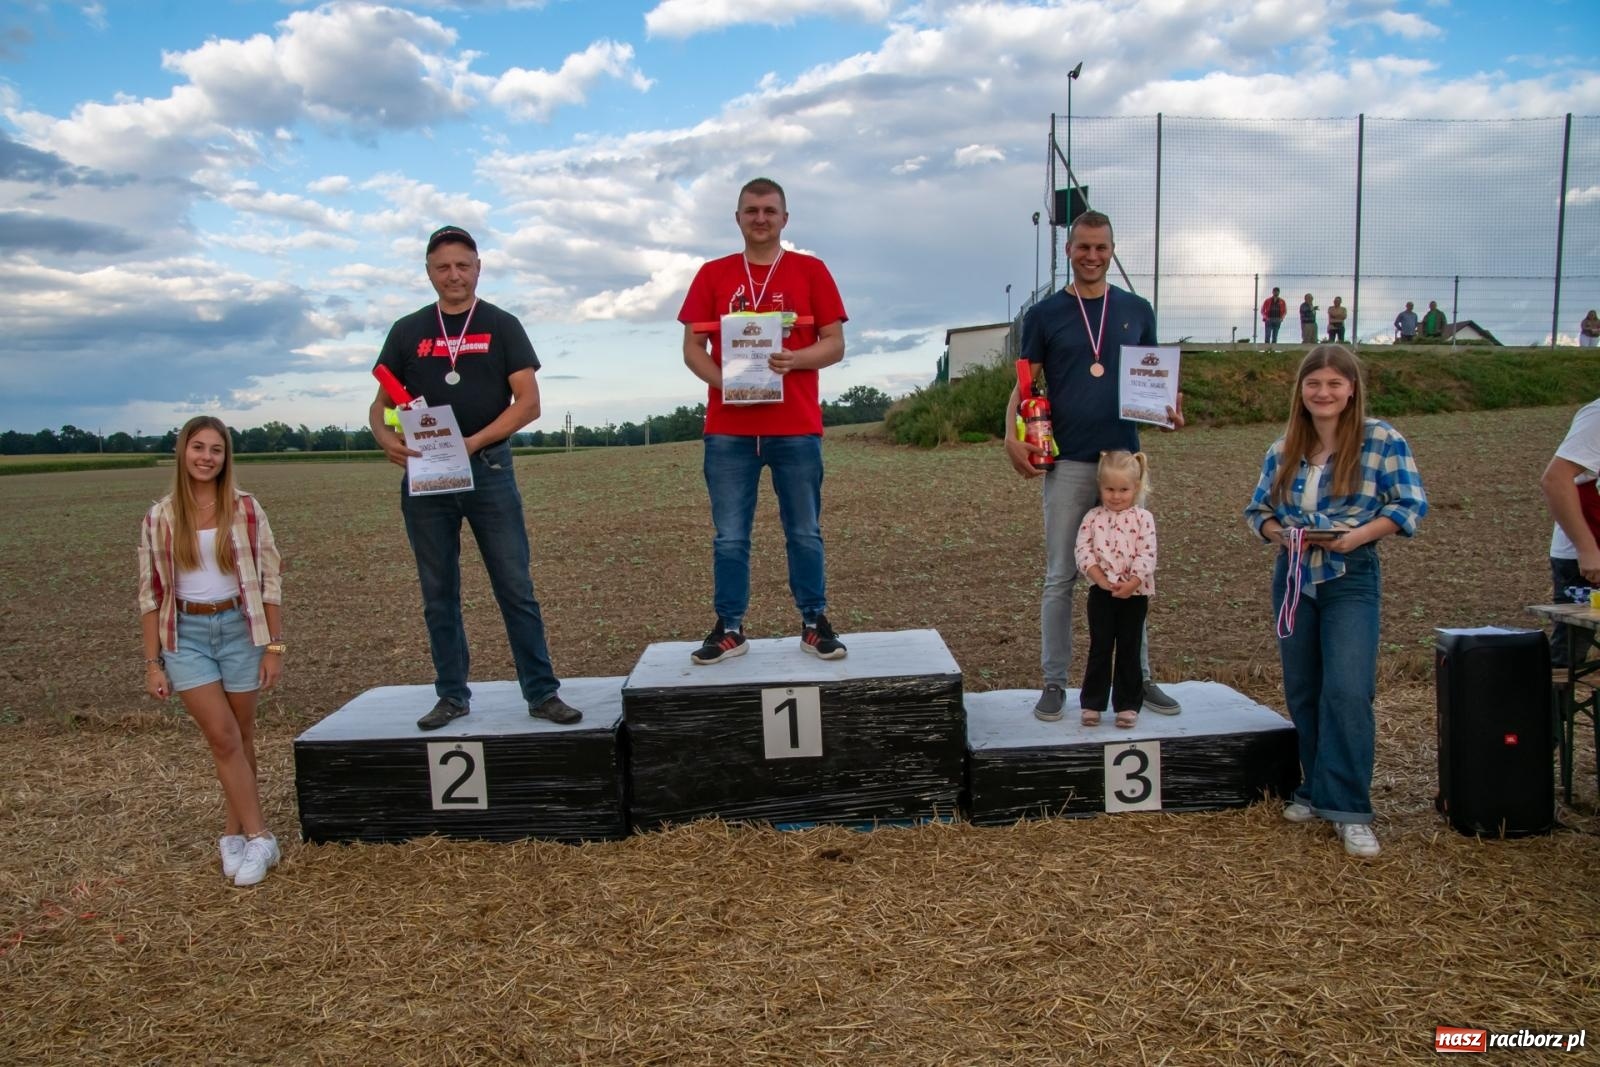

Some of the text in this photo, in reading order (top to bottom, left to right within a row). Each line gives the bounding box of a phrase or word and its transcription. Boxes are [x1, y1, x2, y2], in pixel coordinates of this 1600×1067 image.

[774, 698, 800, 748] 1
[439, 750, 479, 804] 2
[1113, 749, 1152, 804] 3
